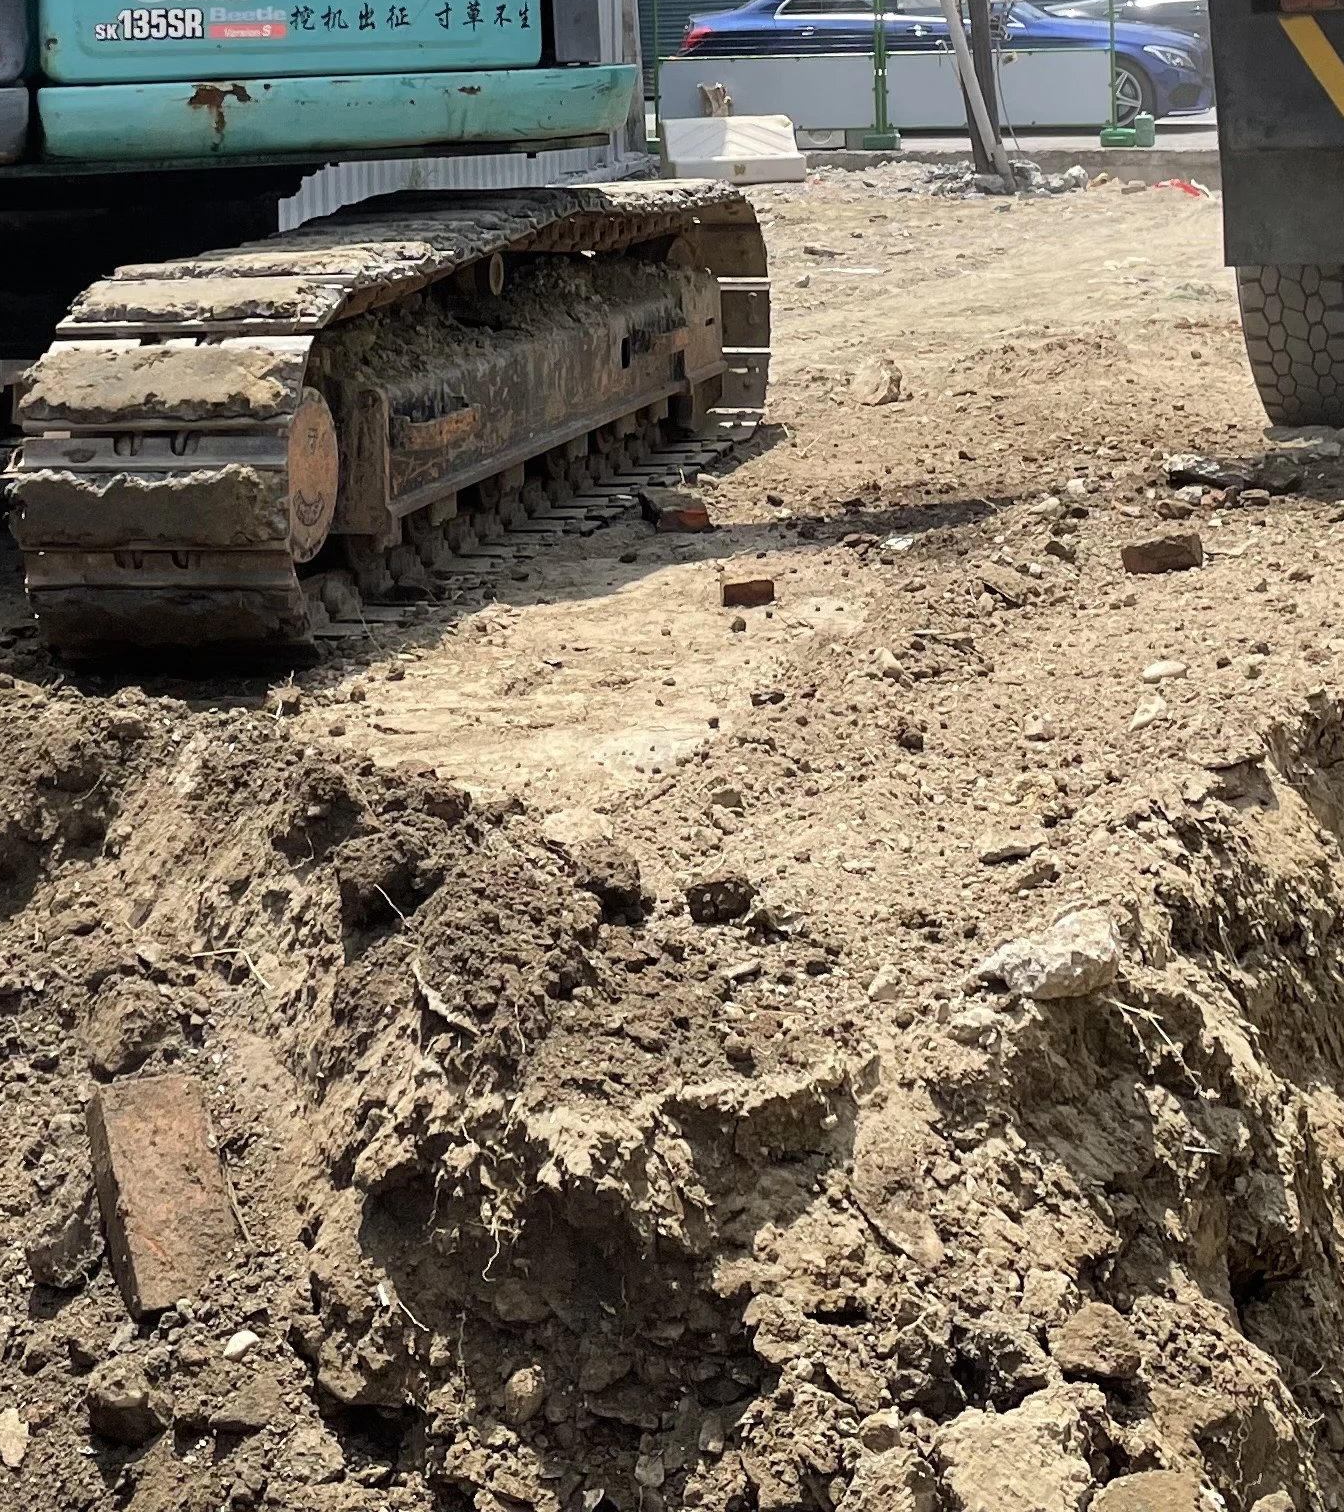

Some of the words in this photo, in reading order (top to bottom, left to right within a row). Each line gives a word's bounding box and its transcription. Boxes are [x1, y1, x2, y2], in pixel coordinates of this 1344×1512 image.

[209, 5, 287, 22] Beetle
[290, 3, 411, 31] 挖机出征
[435, 0, 531, 32] 寸草不生
